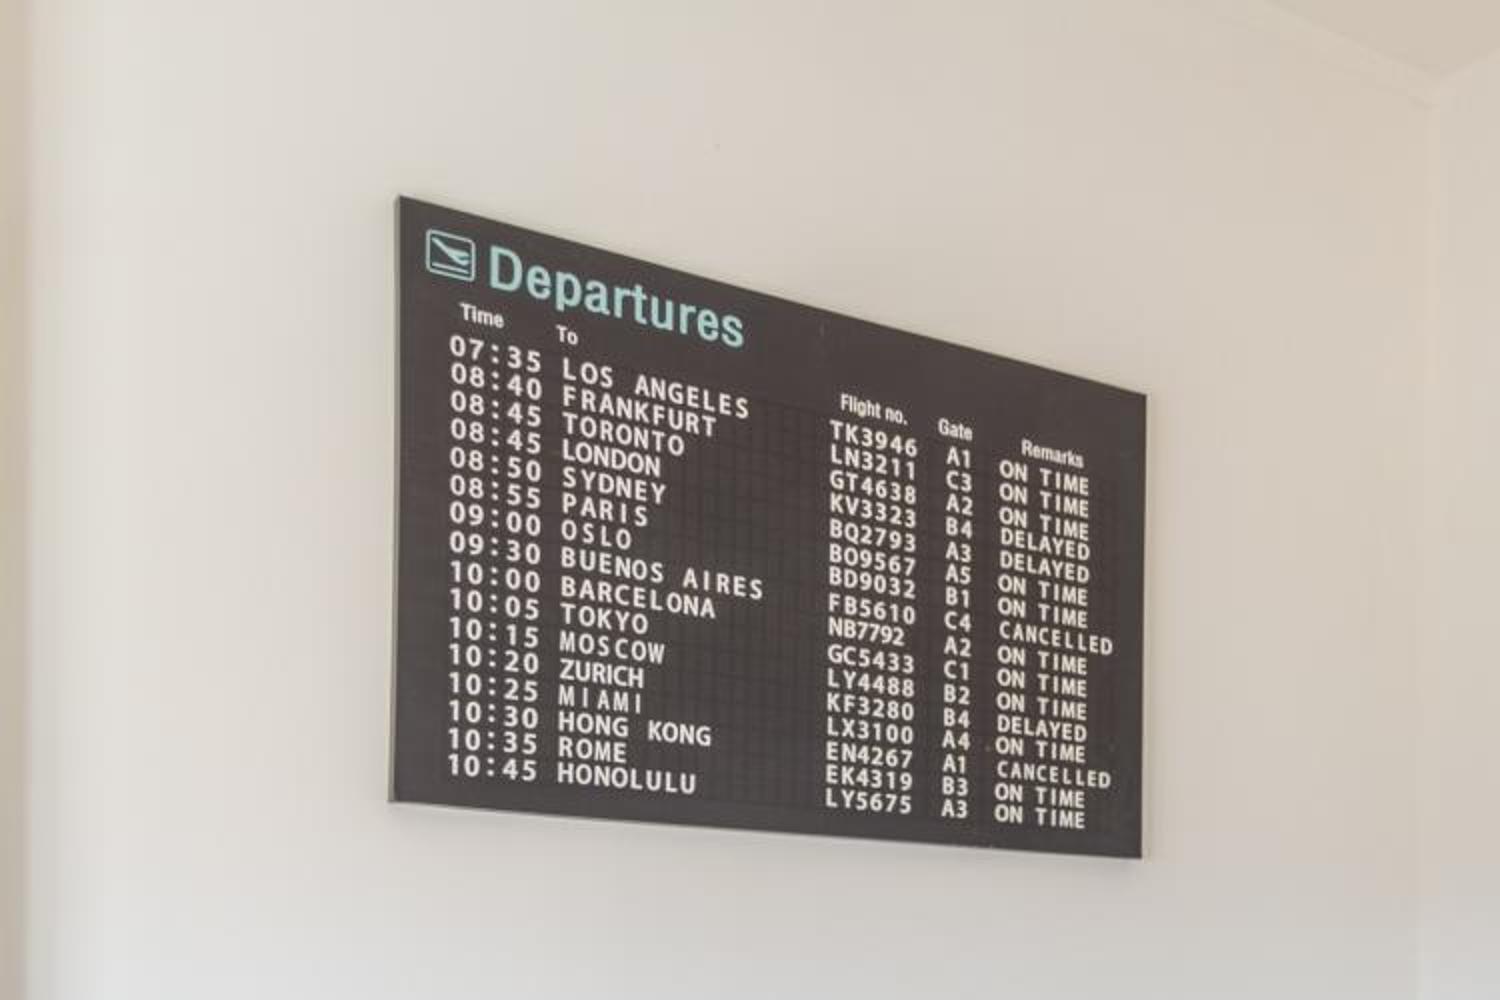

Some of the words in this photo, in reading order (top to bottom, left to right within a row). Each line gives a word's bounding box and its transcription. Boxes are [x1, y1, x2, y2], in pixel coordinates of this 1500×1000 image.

[490, 245, 744, 347] Departures
[449, 334, 541, 373] 07:35
[562, 357, 613, 389] LOS
[634, 374, 749, 419] ANGELES
[829, 419, 918, 458] TK3946
[946, 446, 971, 469] A1
[999, 459, 1028, 483] ON
[1039, 467, 1089, 497] TIME
[450, 362, 543, 401] 08:40
[563, 384, 717, 437] FRANKFURT
[830, 443, 915, 481] LN3211
[946, 469, 972, 493] C3
[999, 482, 1028, 505] ON
[1039, 490, 1089, 519] TIME
[459, 303, 505, 329] Time
[556, 324, 579, 345] To
[840, 393, 881, 419] Flight
[885, 407, 908, 425] no.
[938, 417, 973, 441] Gate
[1021, 438, 1084, 469] Remarks
[449, 446, 542, 483] 08:50
[562, 466, 666, 505] SYDNEY
[829, 517, 916, 553] BQ2793
[945, 541, 972, 563] A3
[999, 549, 1090, 584] DELAYED
[450, 389, 542, 428] 08:45
[562, 411, 685, 457] TORONTO
[829, 469, 917, 505] GT4638
[945, 493, 973, 516] A2
[998, 506, 1028, 529] ON
[1039, 513, 1089, 542] TIME
[450, 417, 541, 455] 08:45
[562, 438, 661, 478] LONDON
[830, 491, 916, 529] KV3323
[945, 516, 973, 539] B4
[1000, 526, 1091, 561] DELAYED
[449, 474, 541, 509] 08:55
[562, 491, 648, 527] PARIS
[829, 542, 916, 577] BO9567
[945, 563, 971, 585] A5
[997, 573, 1027, 596] ON
[1038, 580, 1088, 607] TIME
[449, 500, 541, 537] 09:00
[561, 518, 632, 550] OSLO
[829, 565, 916, 600] BD9032
[945, 585, 970, 609] B1
[997, 596, 1027, 618] ON
[1037, 603, 1088, 629] TIME
[449, 530, 541, 565] 09:30
[561, 545, 664, 584] BUENOS
[682, 567, 763, 600] AIRES
[828, 592, 916, 625] FB5610
[944, 610, 972, 633] C4
[999, 620, 1113, 656] CANCELLED
[449, 616, 539, 649] 10:15
[559, 629, 665, 665] MOSCOW
[827, 667, 915, 698] LY4488
[943, 683, 970, 705] B2
[996, 691, 1025, 713] ON
[1037, 696, 1087, 721] TIME
[450, 560, 541, 593] 10:00
[561, 575, 716, 619] BARCELONA
[828, 616, 905, 647] NB7792
[943, 635, 971, 658] A2
[997, 645, 1026, 667] ON
[1037, 650, 1087, 676] TIME
[450, 587, 539, 621] 10:05
[559, 602, 649, 635] TOKYO
[827, 643, 915, 674] GC5433
[943, 659, 969, 681] C1
[996, 667, 1026, 689] ON
[1037, 673, 1087, 698] TIME
[449, 642, 539, 675] 10:20
[559, 657, 644, 689] ZURICH
[826, 691, 915, 721] KF3280
[943, 707, 970, 729] B4
[997, 714, 1087, 743] DELAYED
[449, 671, 538, 703] 10:25
[558, 684, 641, 714] MIAMI
[827, 715, 914, 745] LX3100
[941, 729, 971, 751] A4
[995, 735, 1024, 757] ON
[1035, 740, 1086, 764] TIME
[449, 699, 539, 730] 10:30
[558, 710, 629, 738] HONG
[647, 719, 712, 747] KONG
[826, 740, 913, 769] EN4267
[942, 753, 966, 774] A1
[997, 760, 1111, 789] CANCELLED
[448, 727, 537, 755] 10:35
[558, 735, 627, 764] ROME
[825, 763, 913, 792] EK4319
[942, 775, 969, 797] B3
[994, 782, 1023, 803] ON
[1035, 786, 1085, 809] TIME
[448, 753, 537, 782] 10:45
[557, 761, 696, 795] HONOLULU
[825, 787, 912, 815] LY5675
[941, 798, 968, 819] A3
[994, 803, 1023, 824] ON
[1035, 807, 1085, 829] TIME
